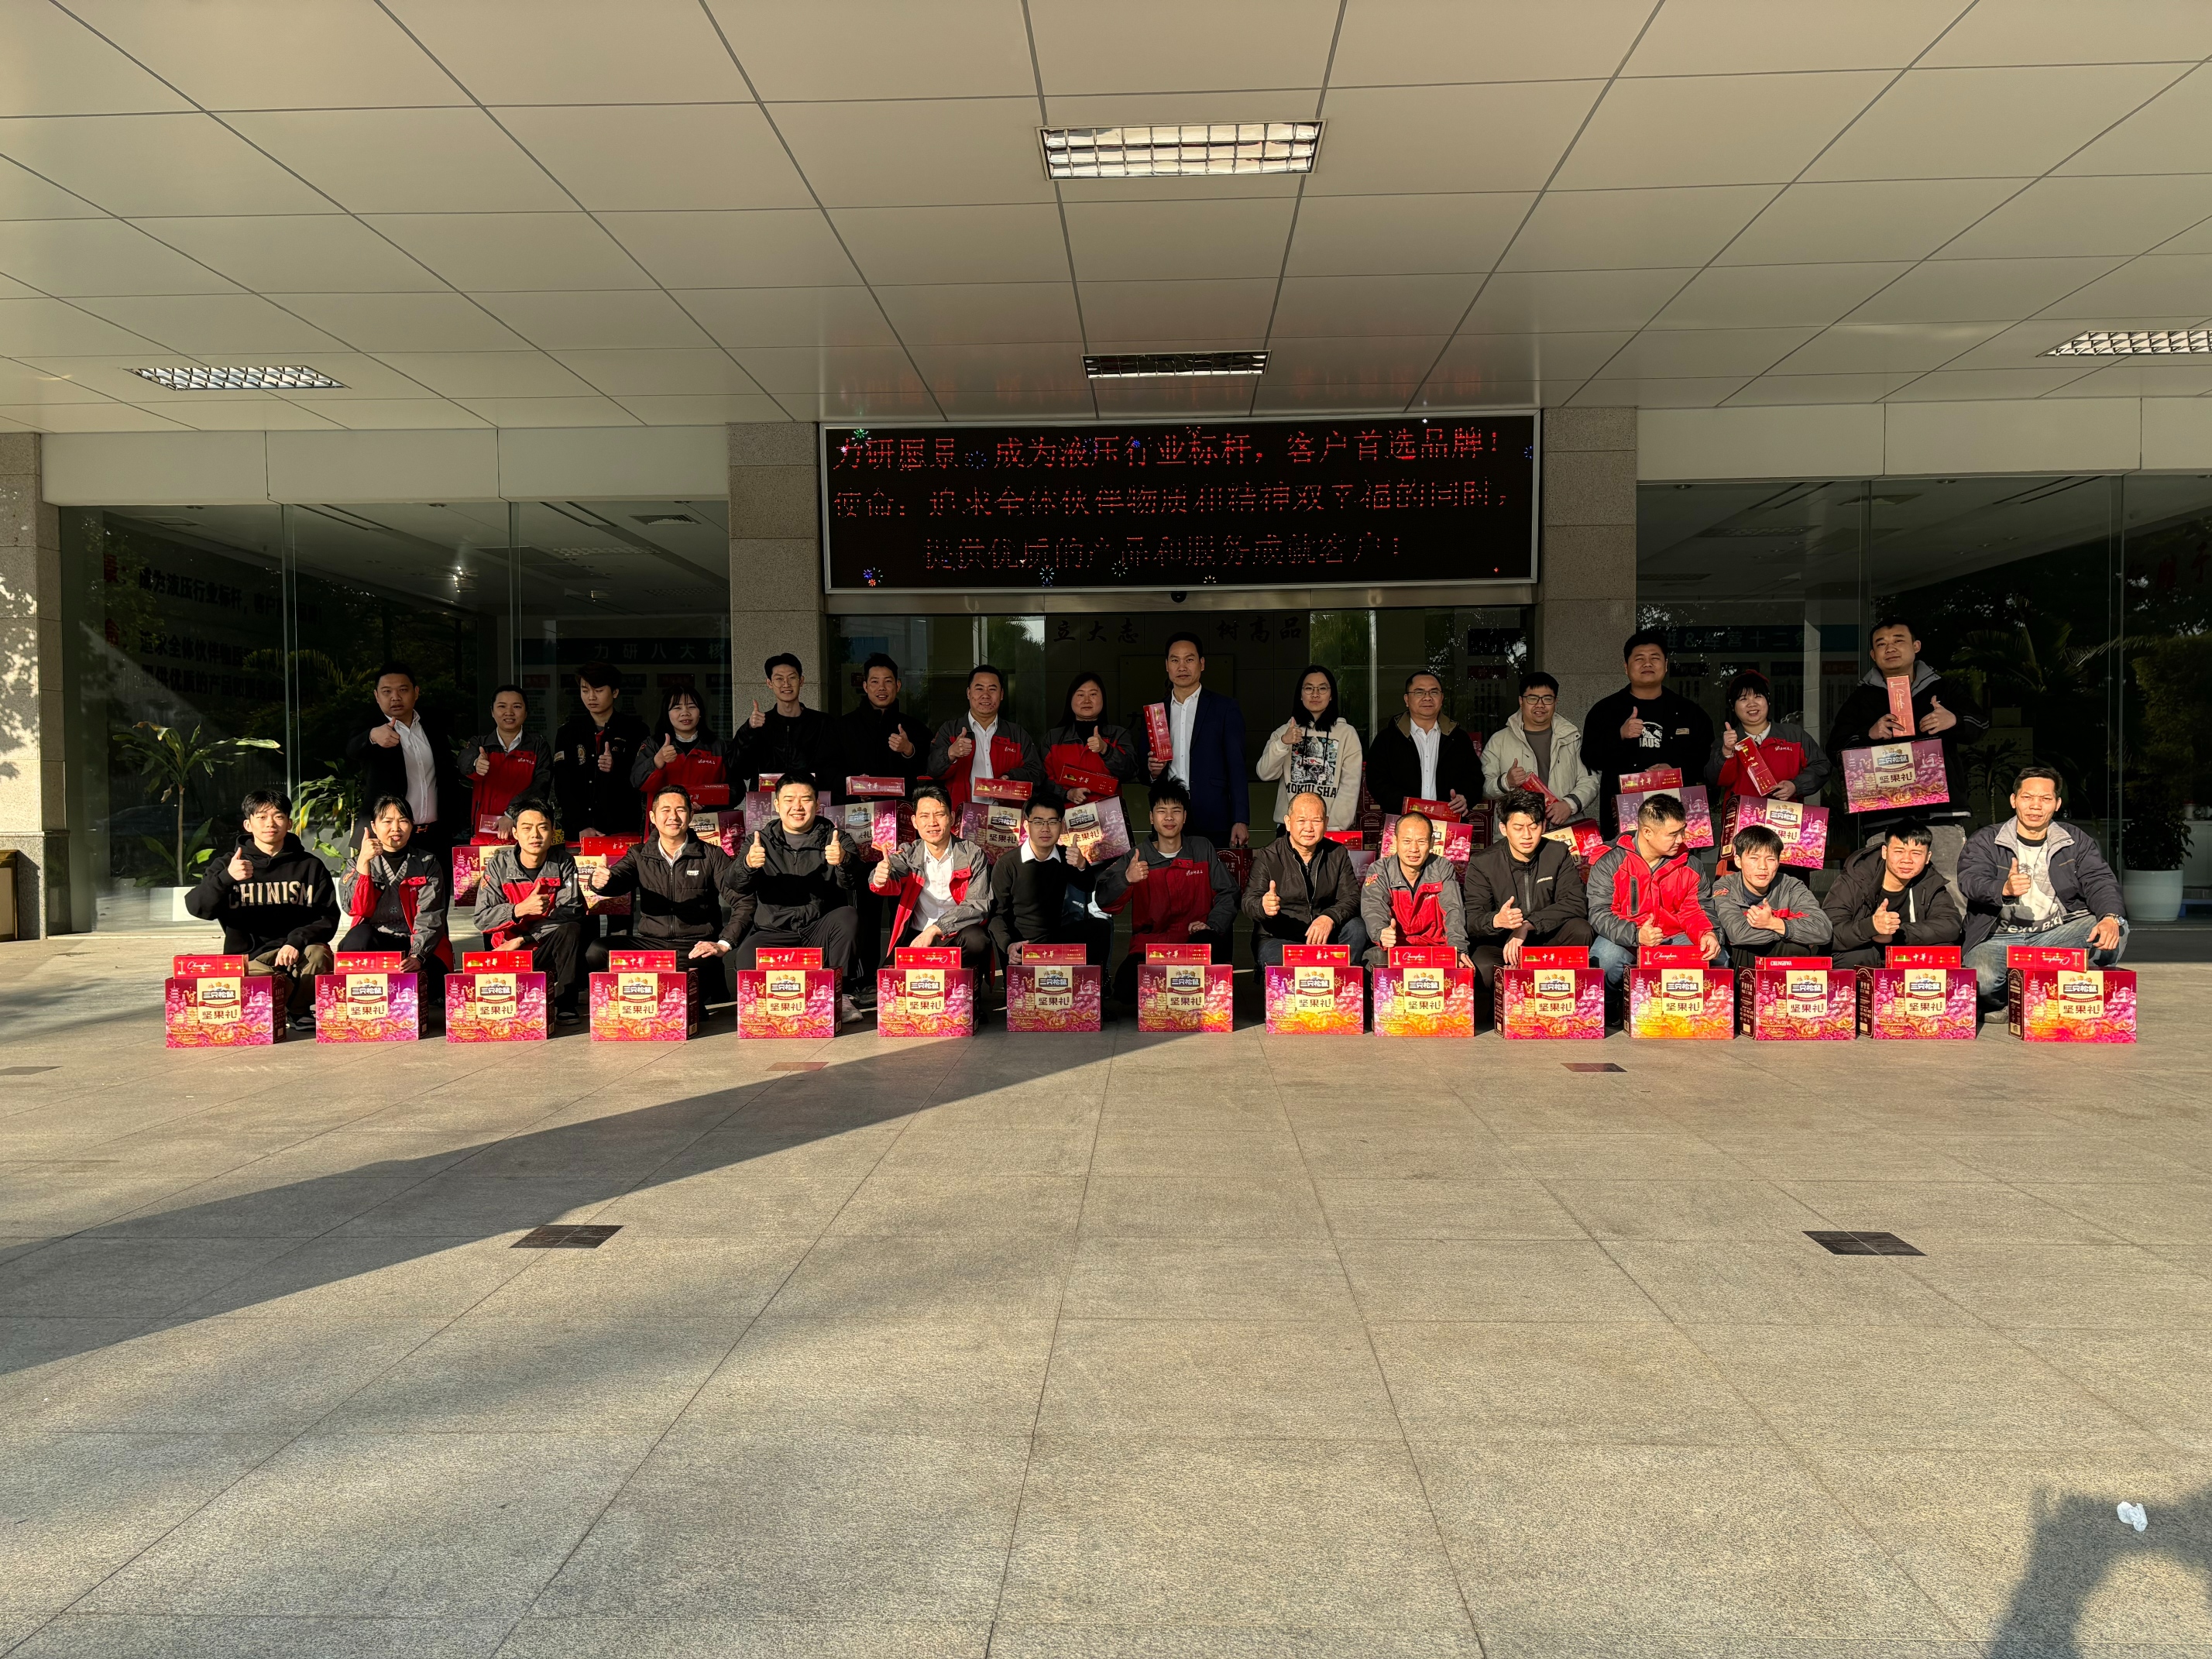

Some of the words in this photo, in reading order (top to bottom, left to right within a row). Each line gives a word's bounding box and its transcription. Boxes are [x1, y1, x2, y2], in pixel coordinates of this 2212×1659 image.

[1053, 620, 1138, 644] 立大志
[228, 881, 313, 909] CHINISM
[910, 1001, 939, 1010] 坚果礼
[1039, 998, 1068, 1006] 坚果礼
[1170, 998, 1199, 1006] 坚果礼
[1300, 999, 1329, 1008] 坚果礼
[1409, 1001, 1438, 1010] 坚果礼
[351, 1006, 382, 1015] 坚果礼
[480, 1006, 510, 1015] 坚果礼
[622, 1006, 651, 1015] 坚果礼
[771, 1003, 801, 1012] 坚果礼
[1539, 1003, 1569, 1012] 坚果礼
[1666, 1003, 1697, 1012] 坚果礼
[1791, 1004, 1822, 1013] 坚果礼
[1909, 1002, 1939, 1012] 坚果礼
[2063, 1005, 2097, 1015] 坚果礼
[202, 1009, 235, 1020] 坚果礼
